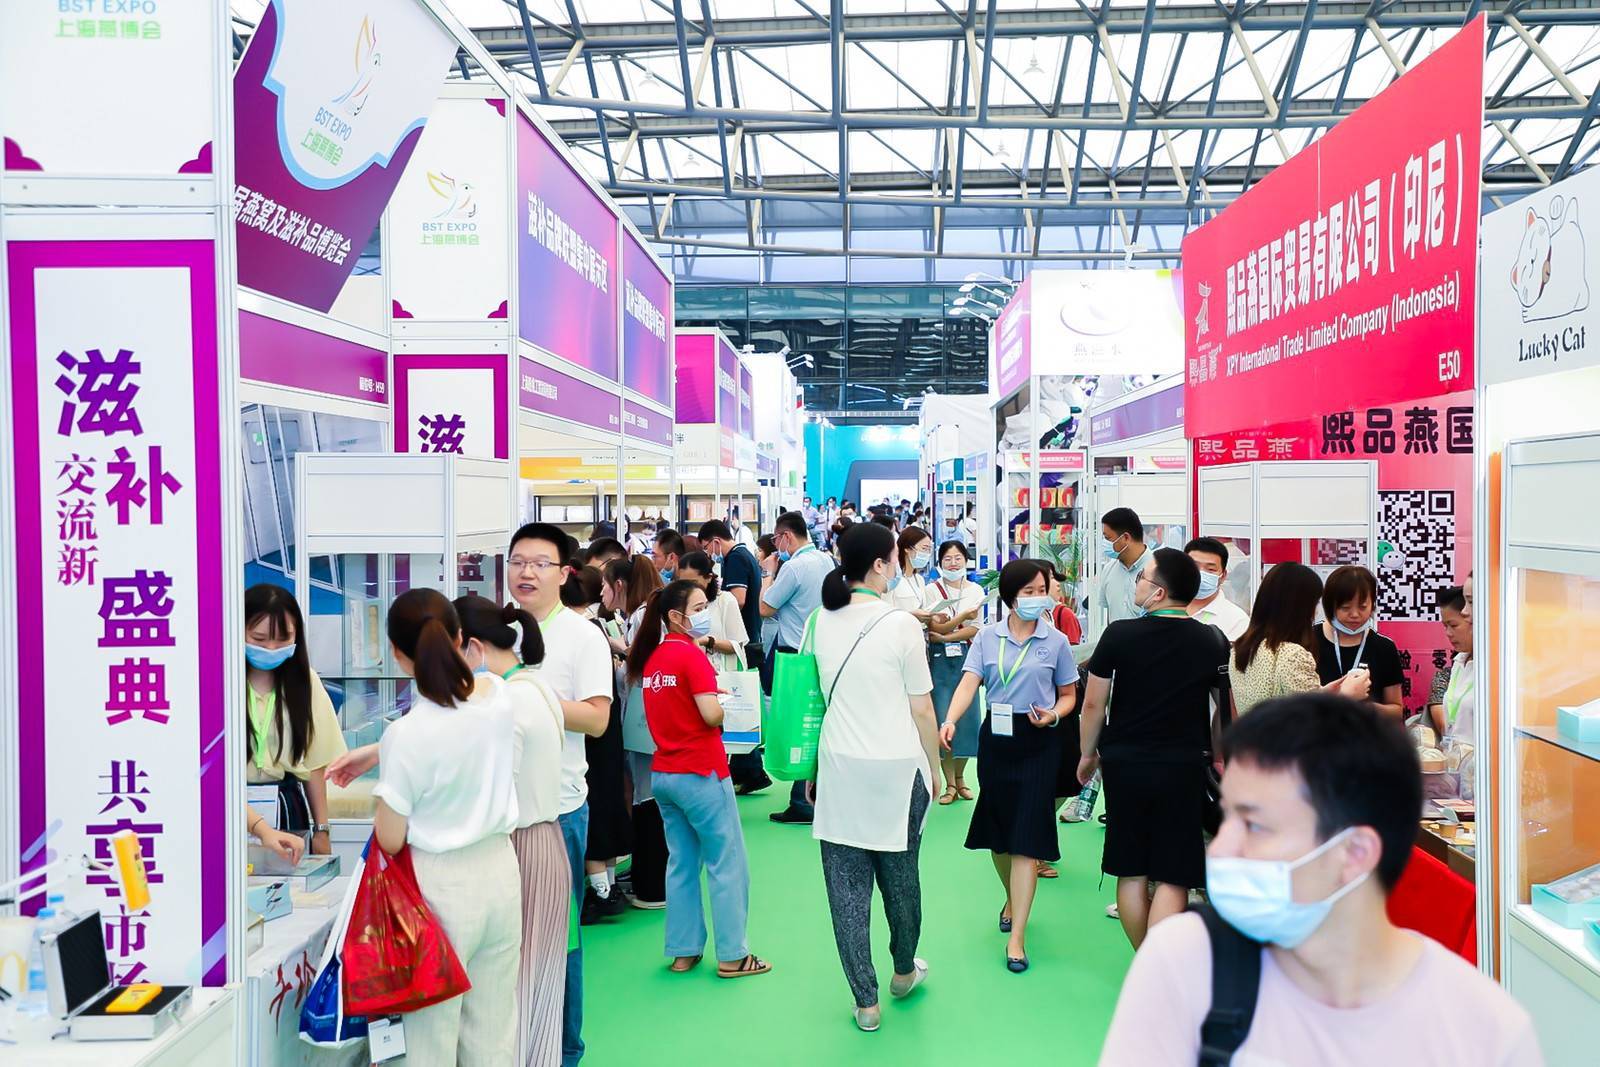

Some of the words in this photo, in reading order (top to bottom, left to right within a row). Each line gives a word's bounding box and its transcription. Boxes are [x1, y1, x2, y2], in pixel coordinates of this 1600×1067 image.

[59, 0, 95, 13] BST
[104, 0, 156, 15] EXPO
[315, 106, 334, 127] BST
[330, 117, 352, 142] EXPO
[422, 222, 444, 231] BST
[447, 222, 477, 231] EXPO
[1226, 351, 1239, 378] XPY
[1239, 341, 1282, 374] International
[1282, 331, 1304, 358] Trade
[1305, 314, 1338, 352] Limited
[1340, 303, 1389, 341] Company
[1391, 271, 1460, 332] (Indonesia)
[1519, 333, 1559, 362] Lucky
[1562, 326, 1586, 352] Cat
[1438, 350, 1461, 382] E50
[1199, 437, 1299, 461] 熙品燕
